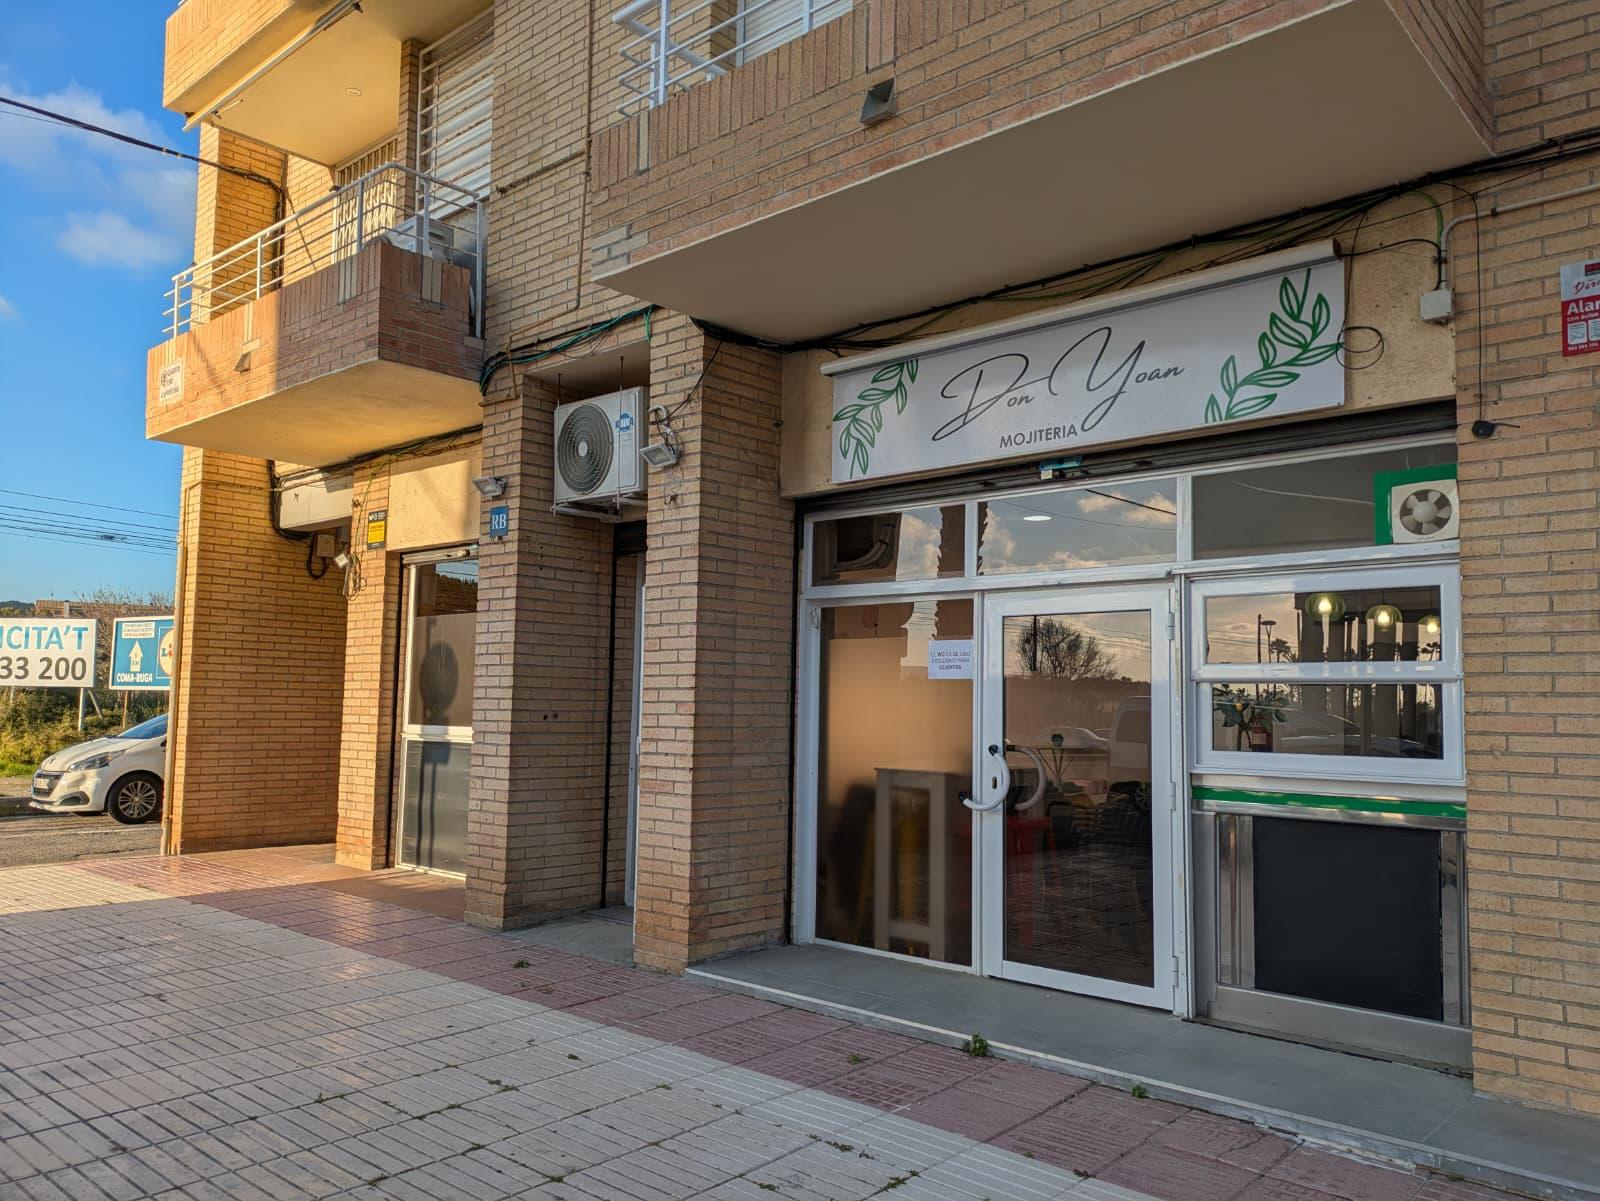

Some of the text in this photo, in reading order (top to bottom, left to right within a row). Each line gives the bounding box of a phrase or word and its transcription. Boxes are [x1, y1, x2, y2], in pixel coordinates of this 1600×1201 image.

[932, 326, 1185, 441] Don Yoan
[1000, 424, 1078, 448] MOJITERIA
[492, 513, 507, 530] RB
[38, 656, 87, 681] 200
